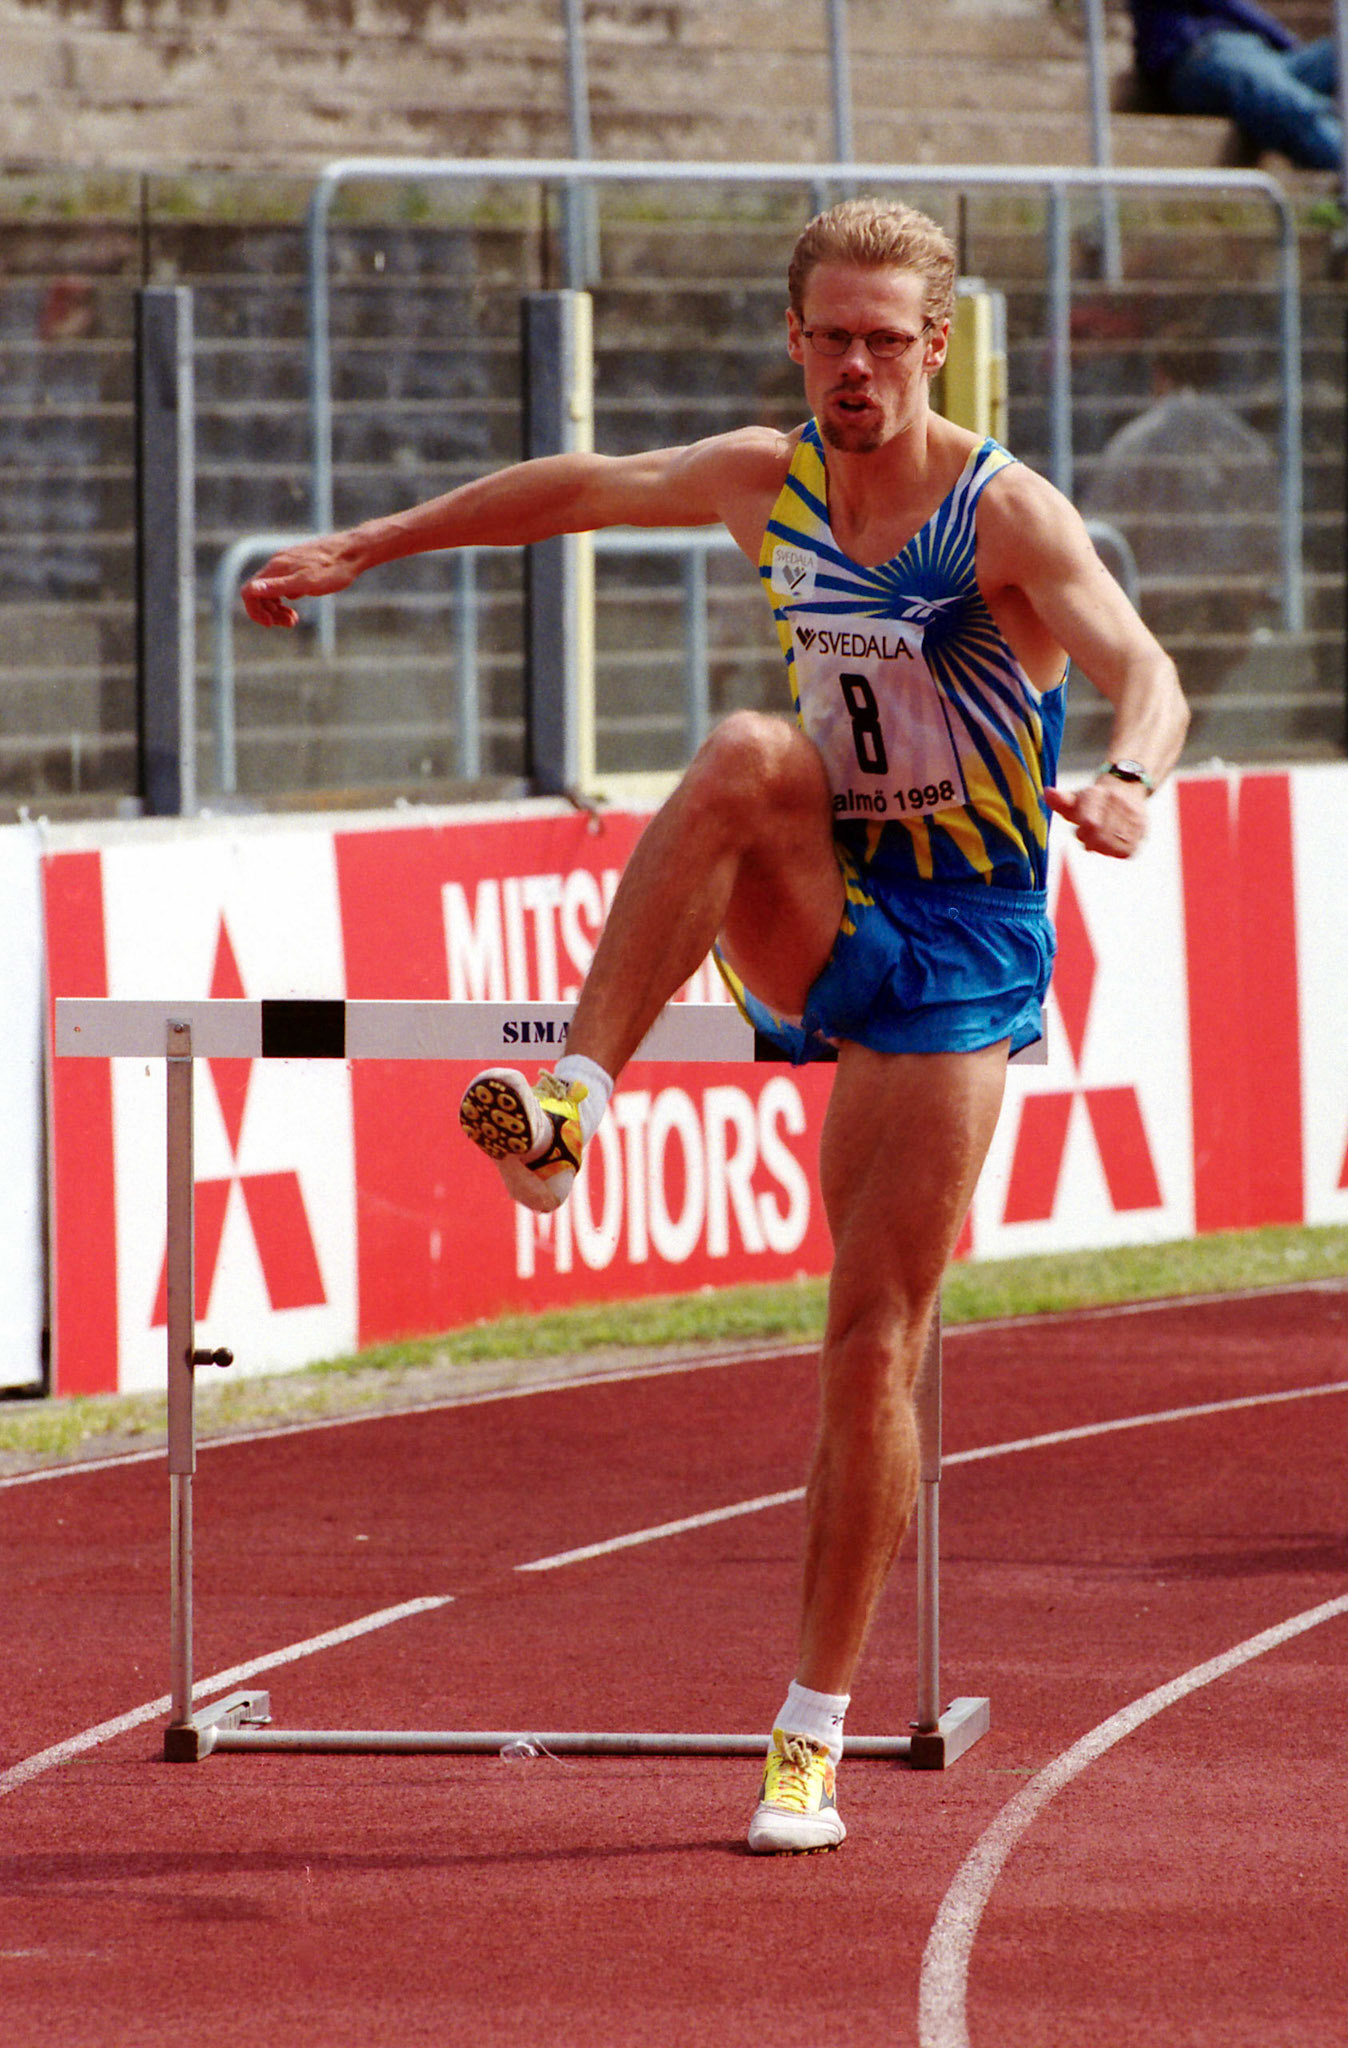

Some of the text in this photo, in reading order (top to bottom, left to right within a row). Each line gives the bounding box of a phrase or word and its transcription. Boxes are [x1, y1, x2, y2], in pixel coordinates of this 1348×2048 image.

[776, 549, 814, 567] SVEDALA
[818, 631, 914, 660] SVEDALA
[840, 673, 888, 775] 8
[832, 780, 955, 813] almö 1998
